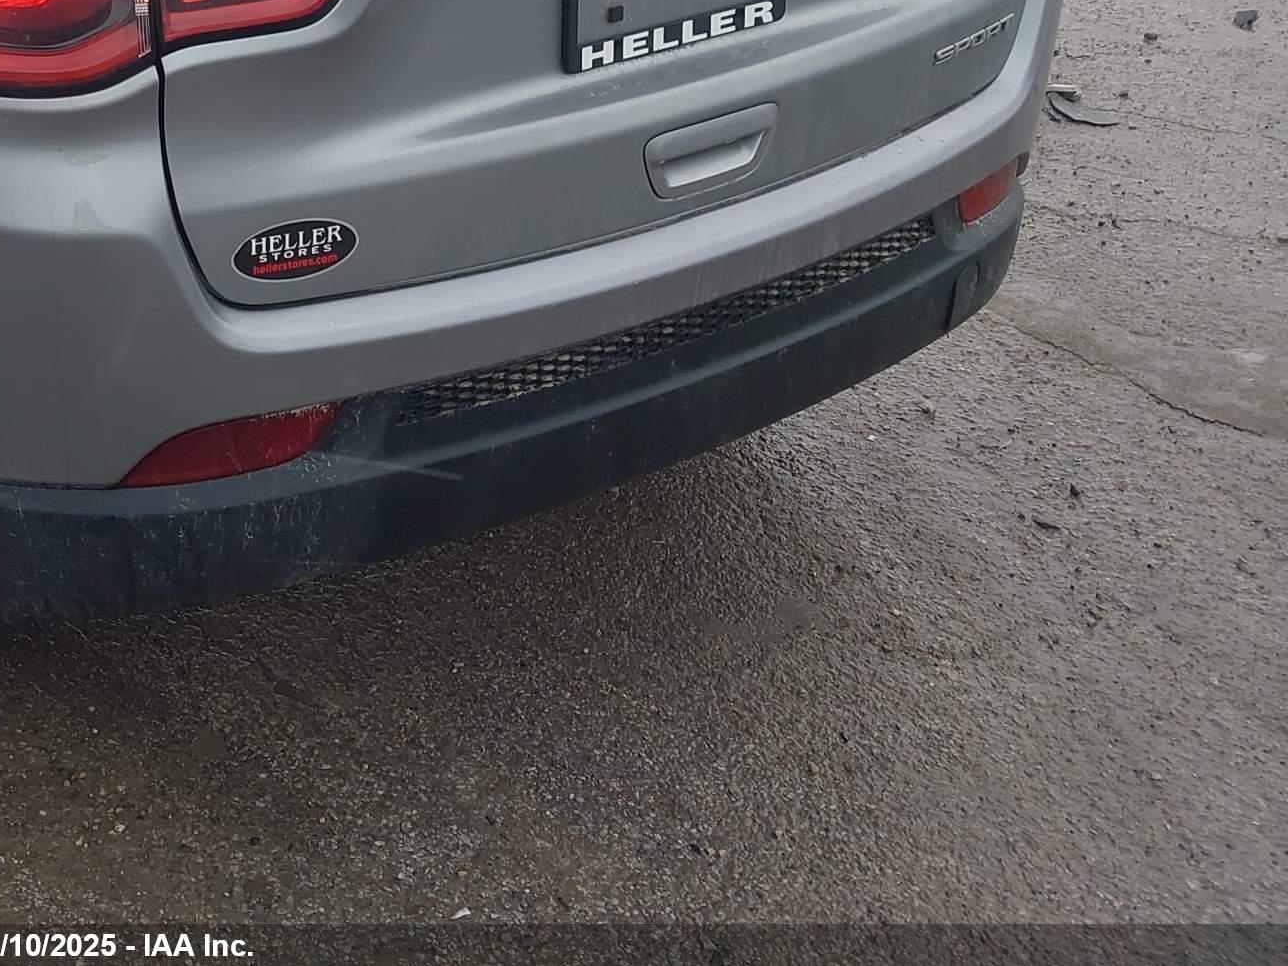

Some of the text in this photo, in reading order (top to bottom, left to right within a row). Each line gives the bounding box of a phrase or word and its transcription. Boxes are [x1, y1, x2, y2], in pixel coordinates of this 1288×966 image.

[581, 0, 774, 71] HELLER
[933, 12, 1015, 65] SPORT
[250, 225, 343, 256] HELLER
[258, 244, 333, 264] STORES
[252, 253, 339, 276] hellerstores.com
